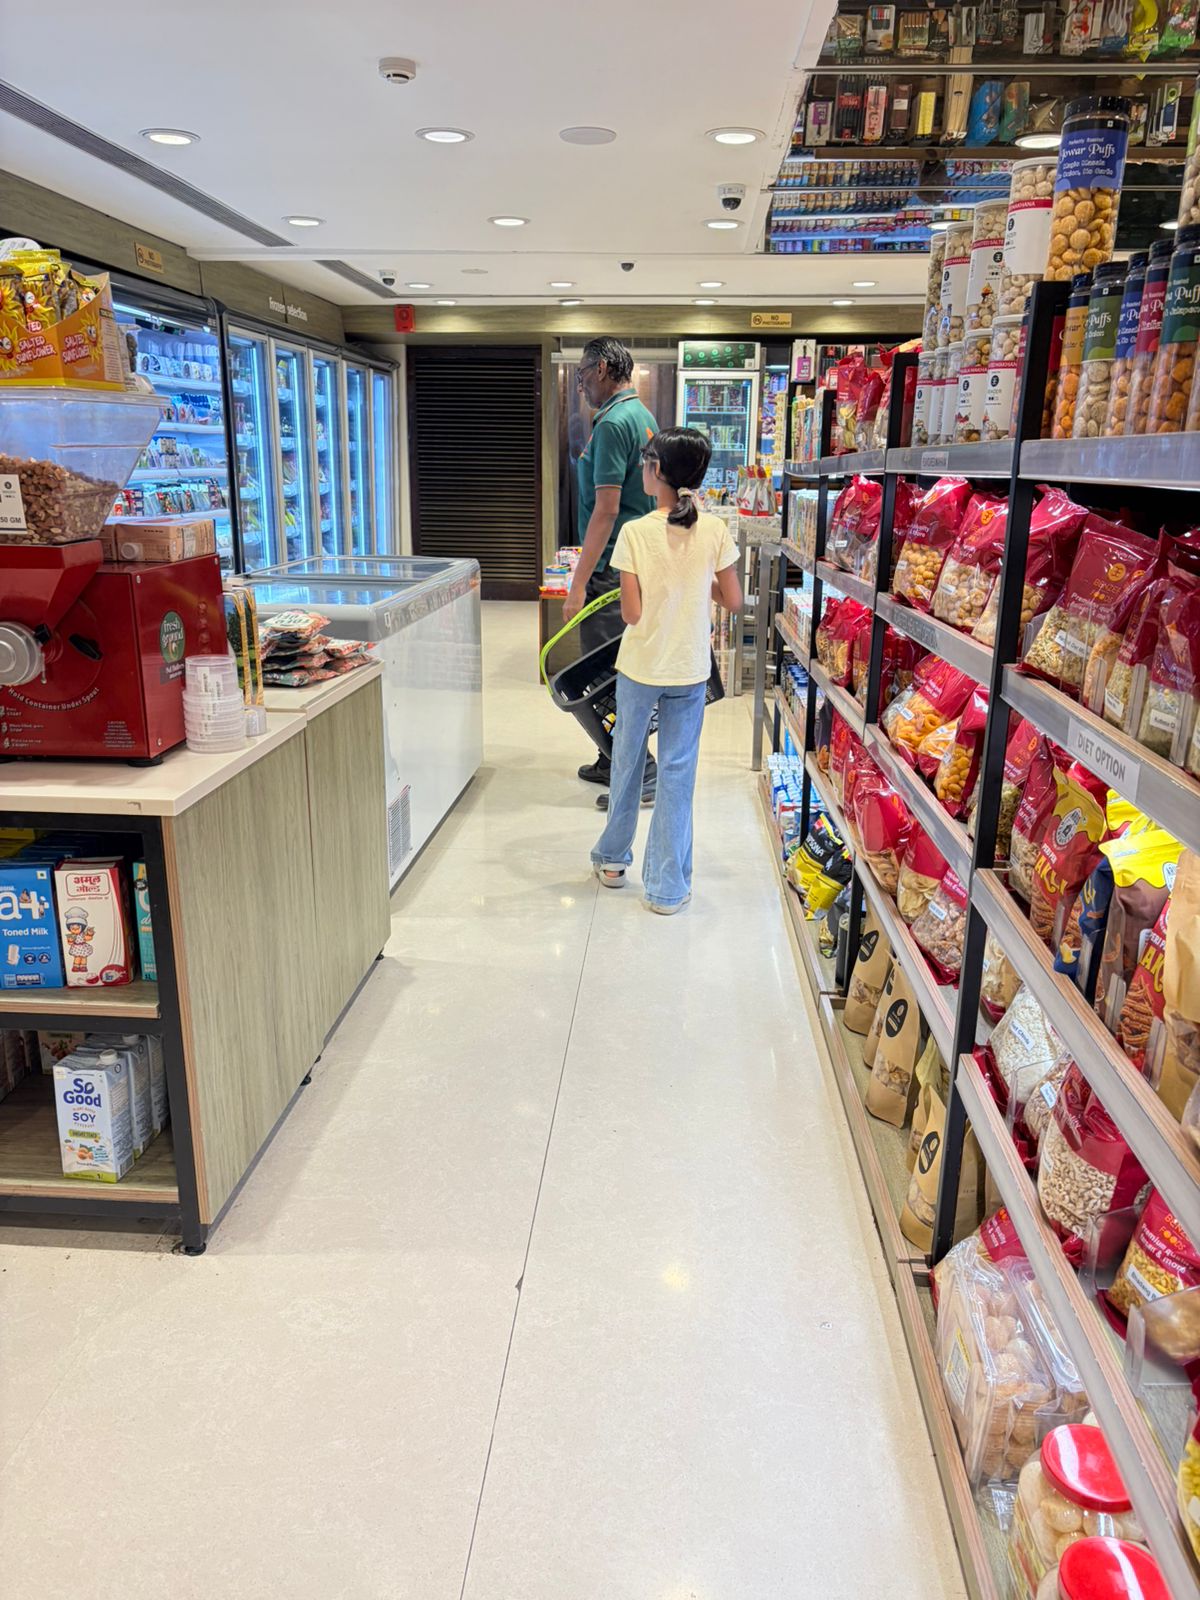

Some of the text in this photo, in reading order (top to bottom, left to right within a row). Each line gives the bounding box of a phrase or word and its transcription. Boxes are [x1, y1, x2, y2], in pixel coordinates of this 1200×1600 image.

[1088, 143, 1116, 159] Puffs
[1174, 283, 1200, 304] Puff
[1090, 312, 1112, 329] Puffs
[19, 335, 45, 351] SALTED
[16, 344, 56, 364] SUNFLOWER
[25, 699, 60, 710] Container
[1077, 733, 1126, 782] DIET OPTION
[2, 927, 48, 937] Toned Milk
[73, 1078, 95, 1095] So
[63, 1090, 102, 1108] Good
[73, 1112, 96, 1123] SOY
[1162, 1257, 1187, 1274] more
